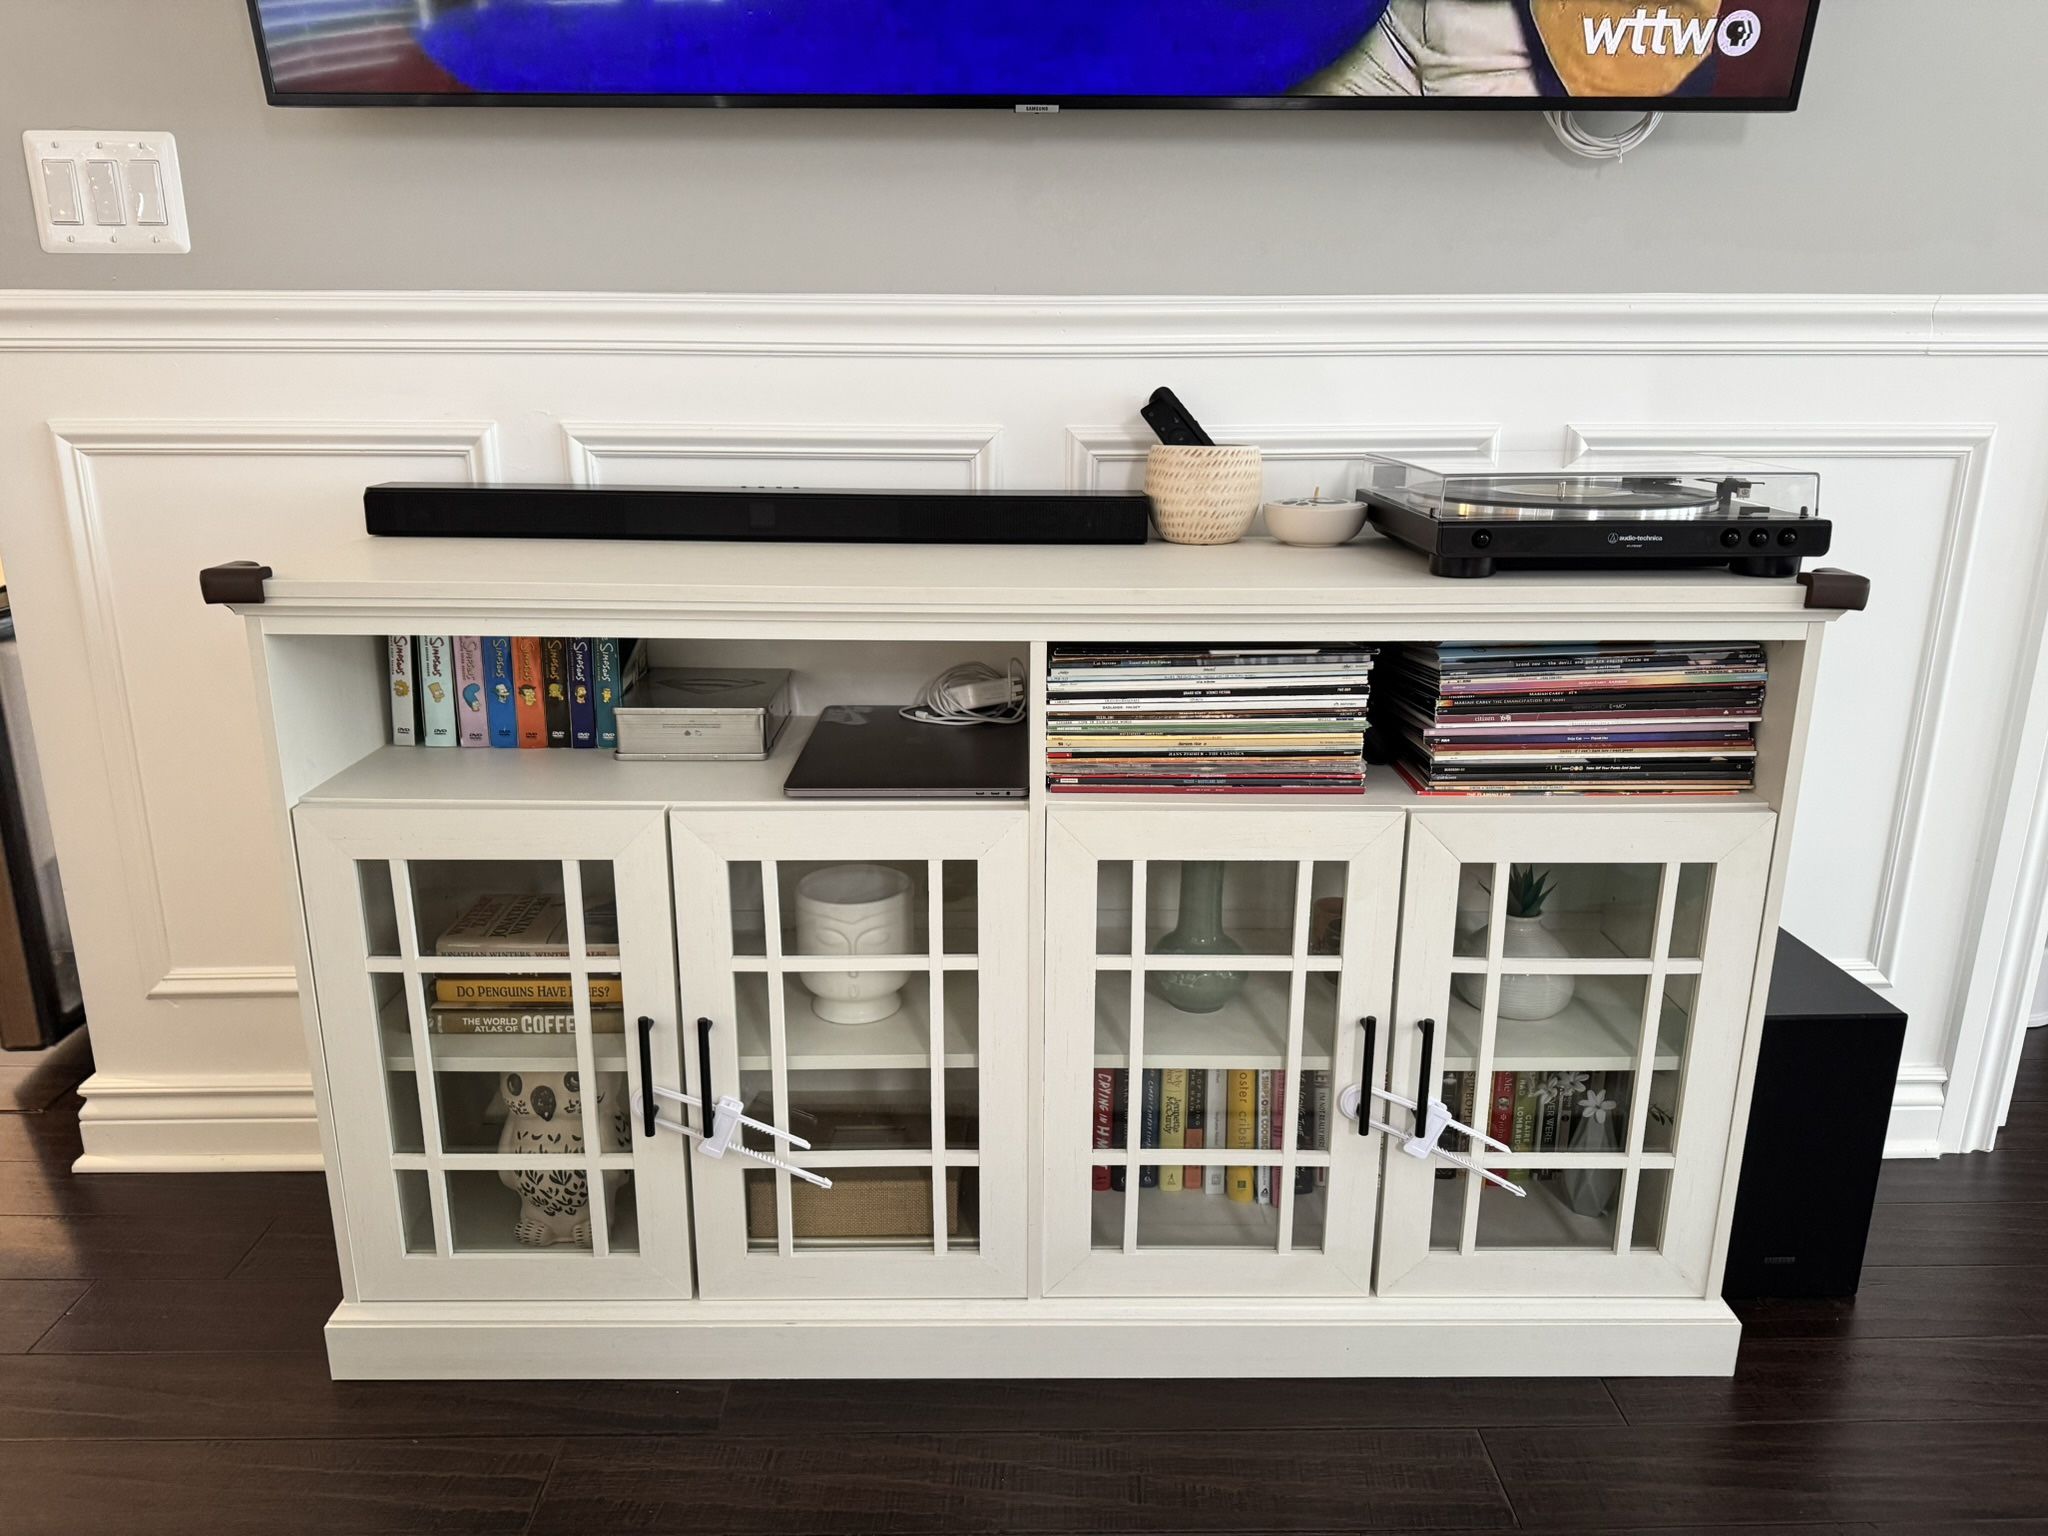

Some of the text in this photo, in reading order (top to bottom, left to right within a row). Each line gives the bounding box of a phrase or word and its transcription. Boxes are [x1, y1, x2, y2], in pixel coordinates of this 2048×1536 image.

[1583, 8, 1718, 55] wttw
[478, 986, 534, 997] PENGUINS
[538, 986, 567, 997] HAVE
[521, 1015, 576, 1033] COFFE
[1098, 1073, 1112, 1111] CRYING
[1504, 1078, 1512, 1092] Me
[1099, 1114, 1108, 1124] IN
[1163, 1096, 1174, 1134] McCurdy
[1173, 1098, 1182, 1133] Jennette
[1238, 1072, 1251, 1149] oster cribsh
[1514, 1106, 1524, 1151] LOMBARDO
[1523, 1115, 1532, 1142] CLAIRE
[1544, 1117, 1554, 1143] WERE
